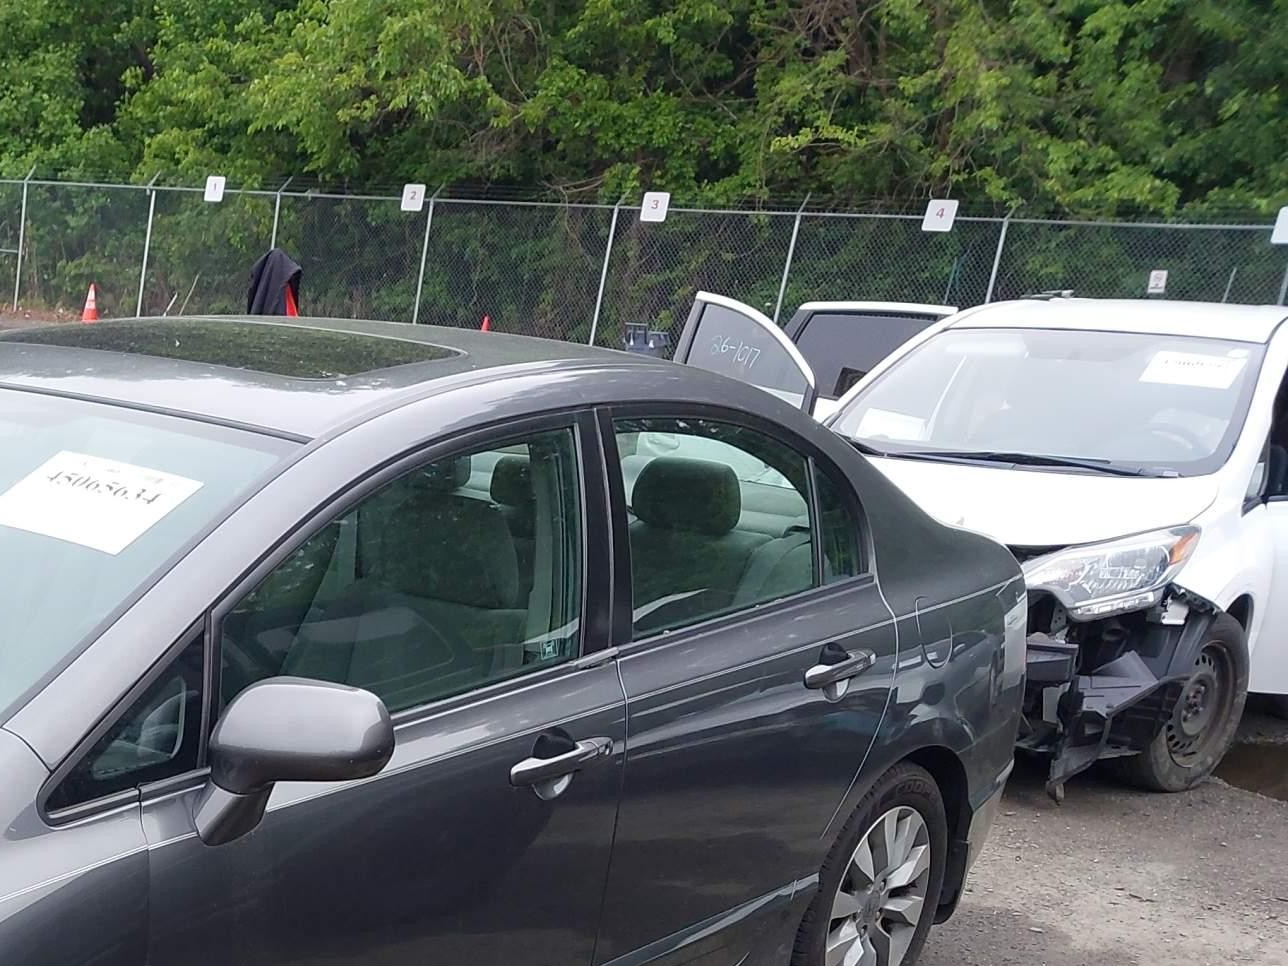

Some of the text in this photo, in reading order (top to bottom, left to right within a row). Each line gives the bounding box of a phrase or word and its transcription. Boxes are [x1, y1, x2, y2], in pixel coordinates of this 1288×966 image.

[650, 199, 660, 210] 3
[935, 207, 945, 219] 4
[46, 471, 165, 505] 45065634
